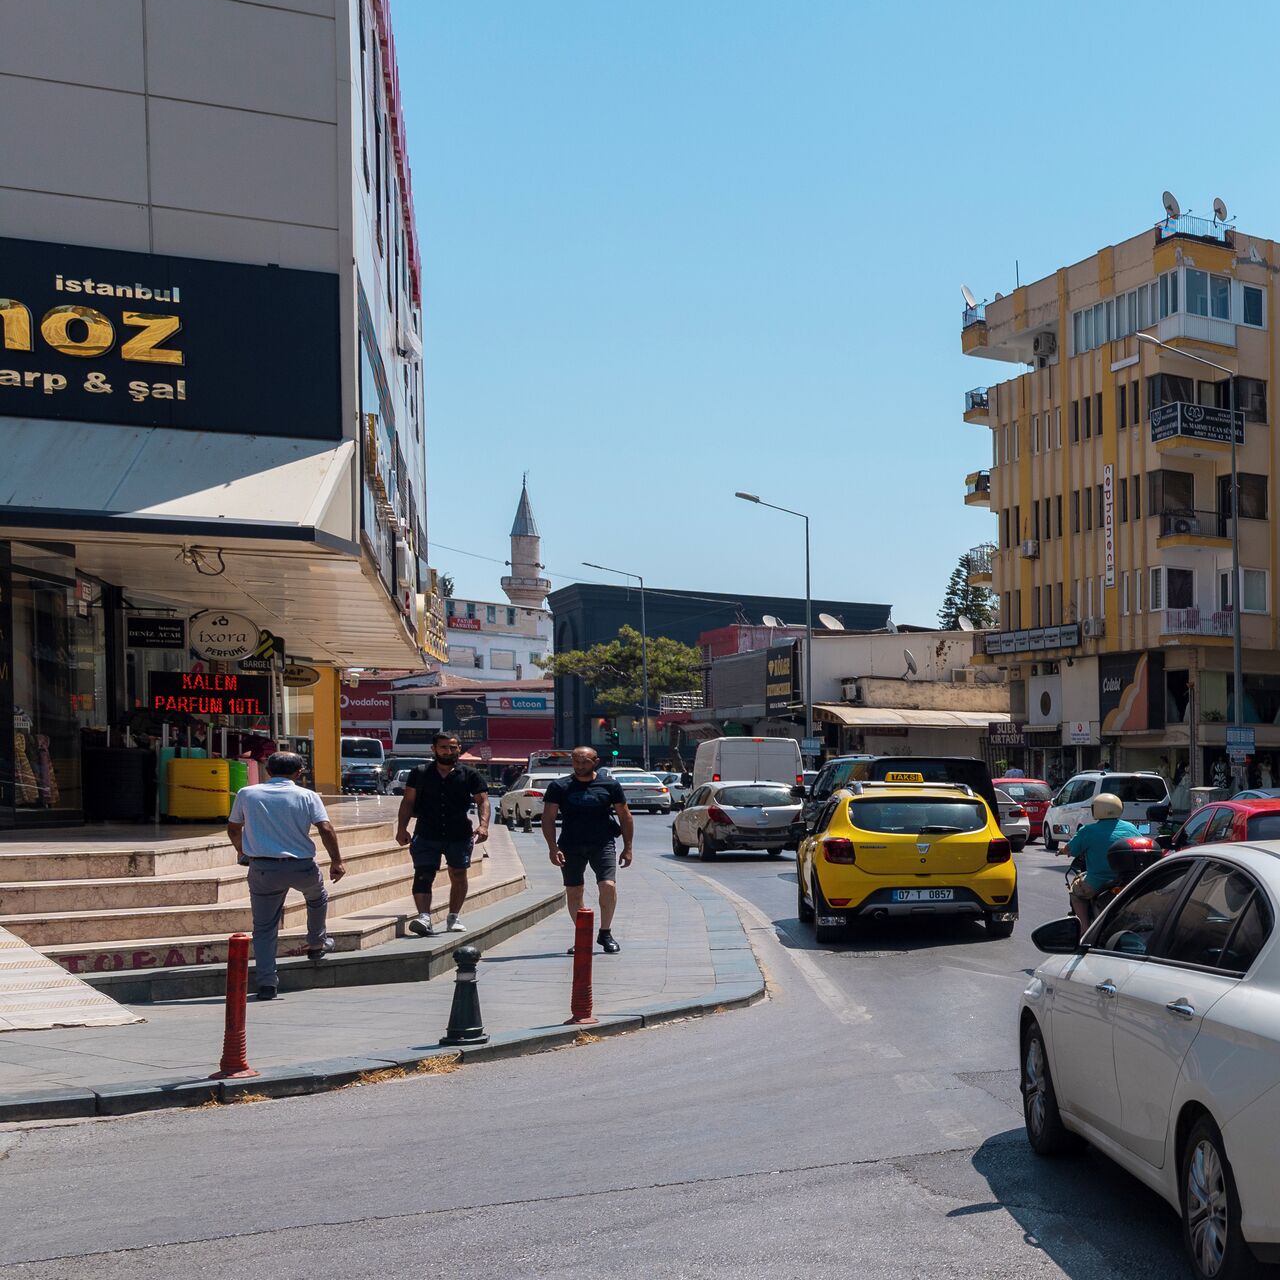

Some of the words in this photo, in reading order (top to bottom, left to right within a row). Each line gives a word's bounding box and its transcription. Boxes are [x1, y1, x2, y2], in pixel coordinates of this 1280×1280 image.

[55, 274, 181, 303] istanbul
[83, 372, 113, 394] &
[128, 380, 187, 402] şal
[157, 631, 182, 639] ACAR
[204, 645, 249, 658] PERFUME
[182, 673, 238, 692] KALEM
[154, 695, 223, 714] PARFÜM
[228, 698, 264, 715] 10TL
[350, 697, 390, 709] vodafone
[990, 732, 1025, 745] KIRTASİYE
[899, 890, 910, 899] 07
[916, 890, 922, 899] T
[929, 889, 951, 899] 0857
